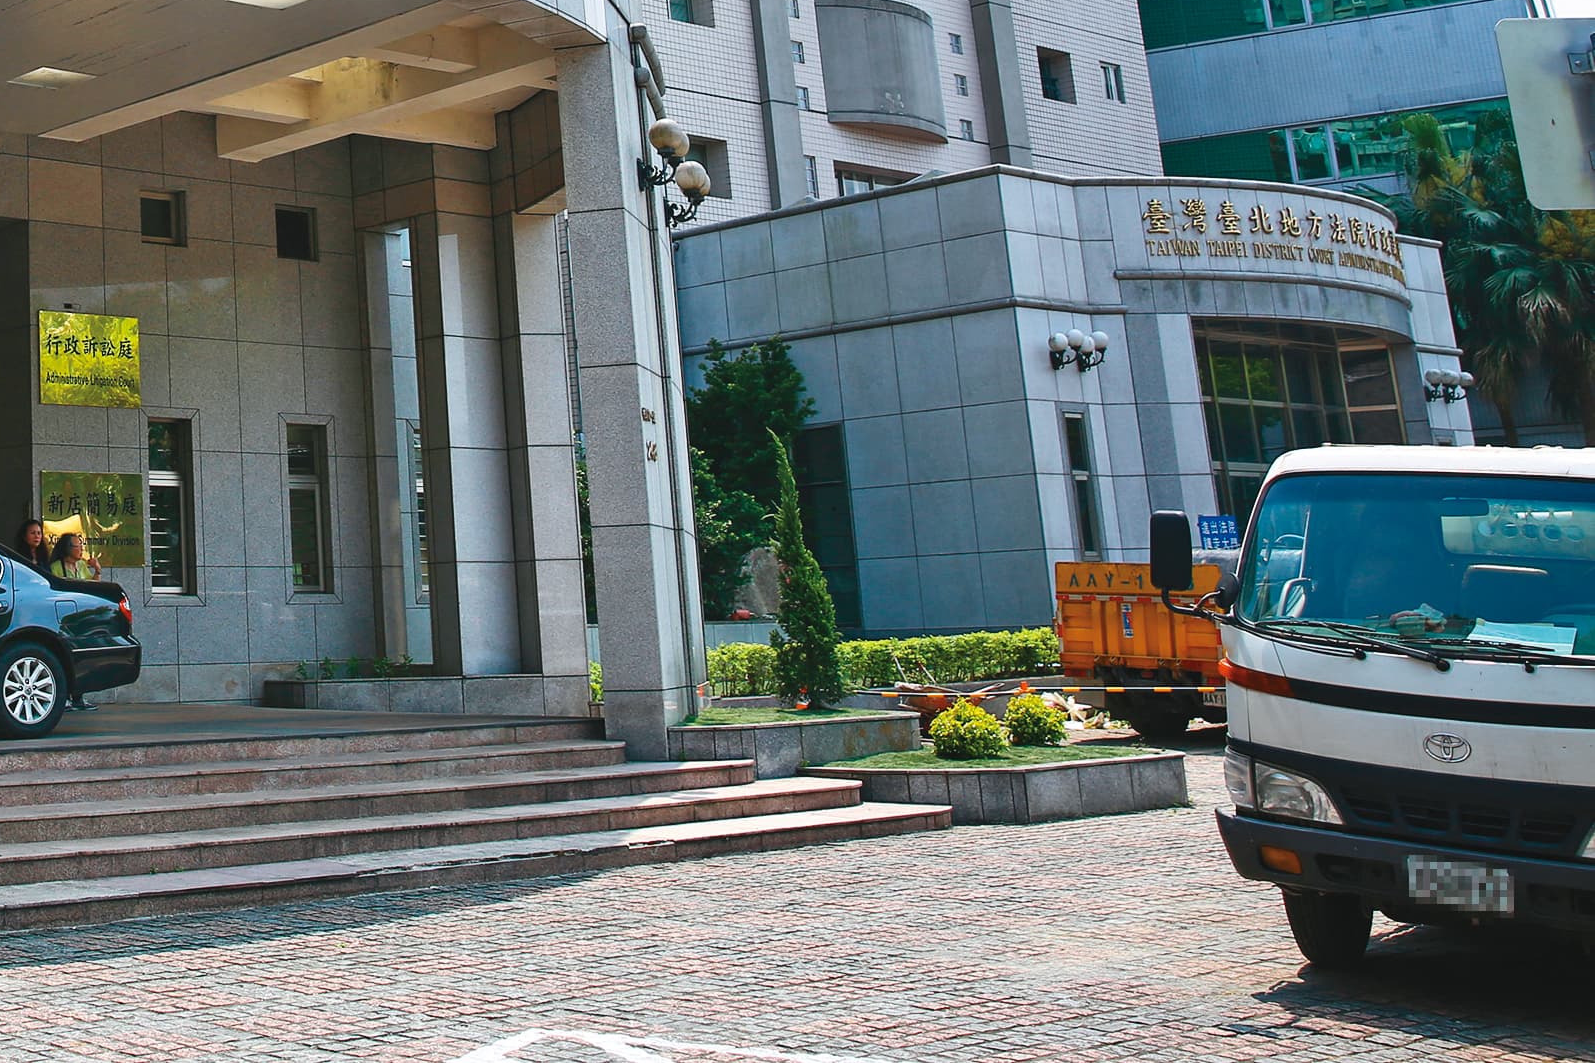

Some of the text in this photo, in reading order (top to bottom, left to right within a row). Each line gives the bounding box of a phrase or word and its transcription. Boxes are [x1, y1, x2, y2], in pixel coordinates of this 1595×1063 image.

[1146, 239, 1201, 257] TAIWAN
[1207, 240, 1248, 258] TAIPEI
[1254, 241, 1304, 262] DISTRICT
[1308, 247, 1335, 265] COURT
[45, 333, 134, 359] 行政訴訟庭
[48, 491, 138, 516] 新店簡易庭
